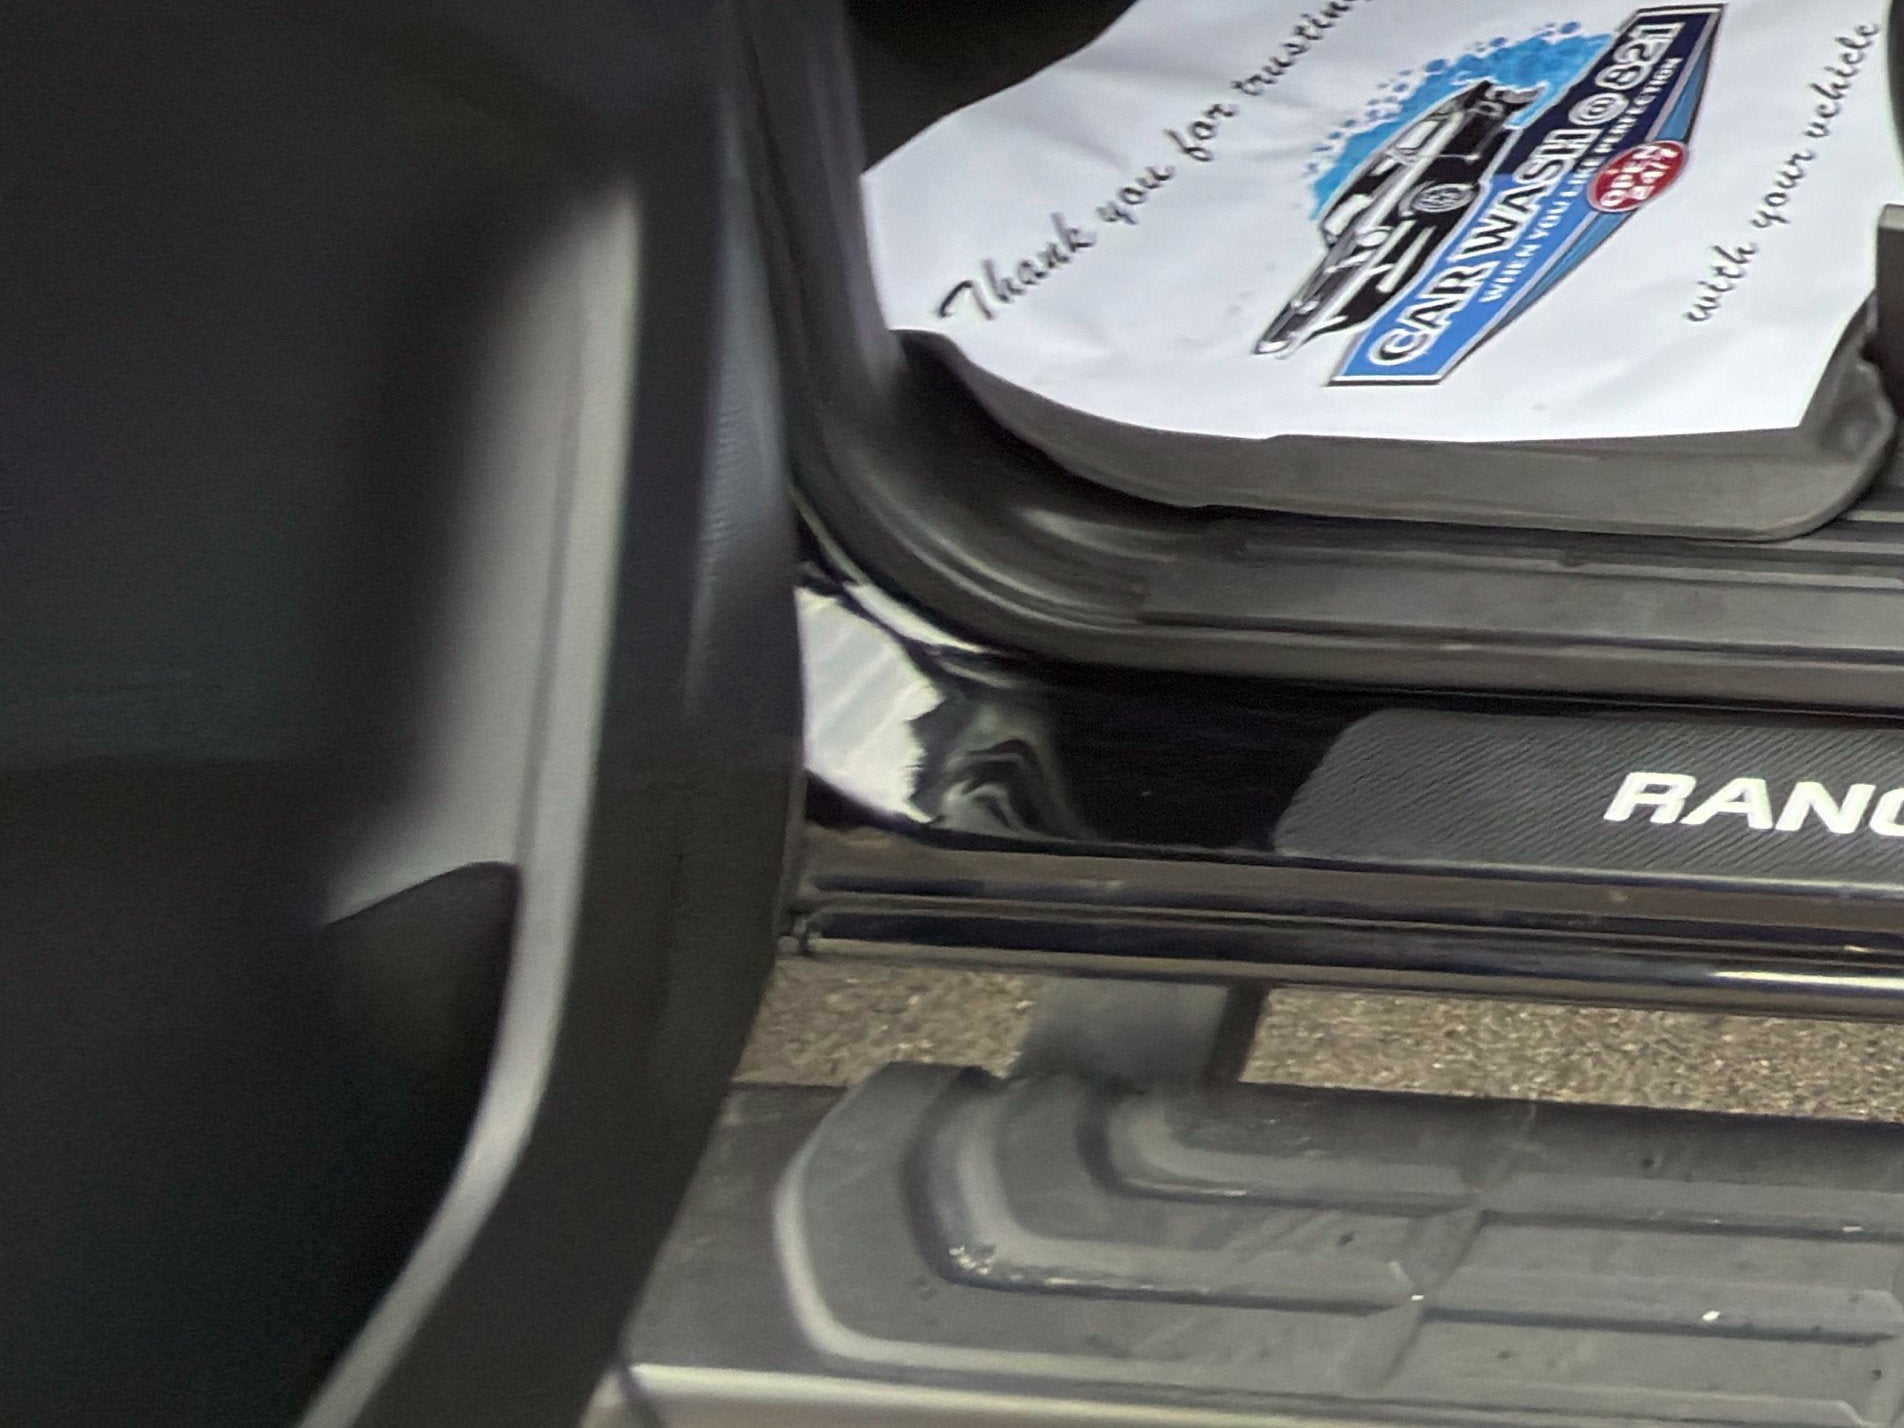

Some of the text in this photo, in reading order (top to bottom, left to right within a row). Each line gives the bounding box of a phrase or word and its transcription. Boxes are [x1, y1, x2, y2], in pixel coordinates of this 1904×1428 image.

[935, 210, 1098, 320] Thank
[1096, 164, 1176, 226] you
[1164, 102, 1239, 162] for
[1368, 21, 1686, 366] CAR WASH @ 821
[1480, 242, 1540, 304] WHEN
[1532, 193, 1571, 243] YOU
[1559, 156, 1602, 197] LIKE
[1600, 144, 1662, 207] OPEN
[1684, 21, 1880, 323] with your vehicle
